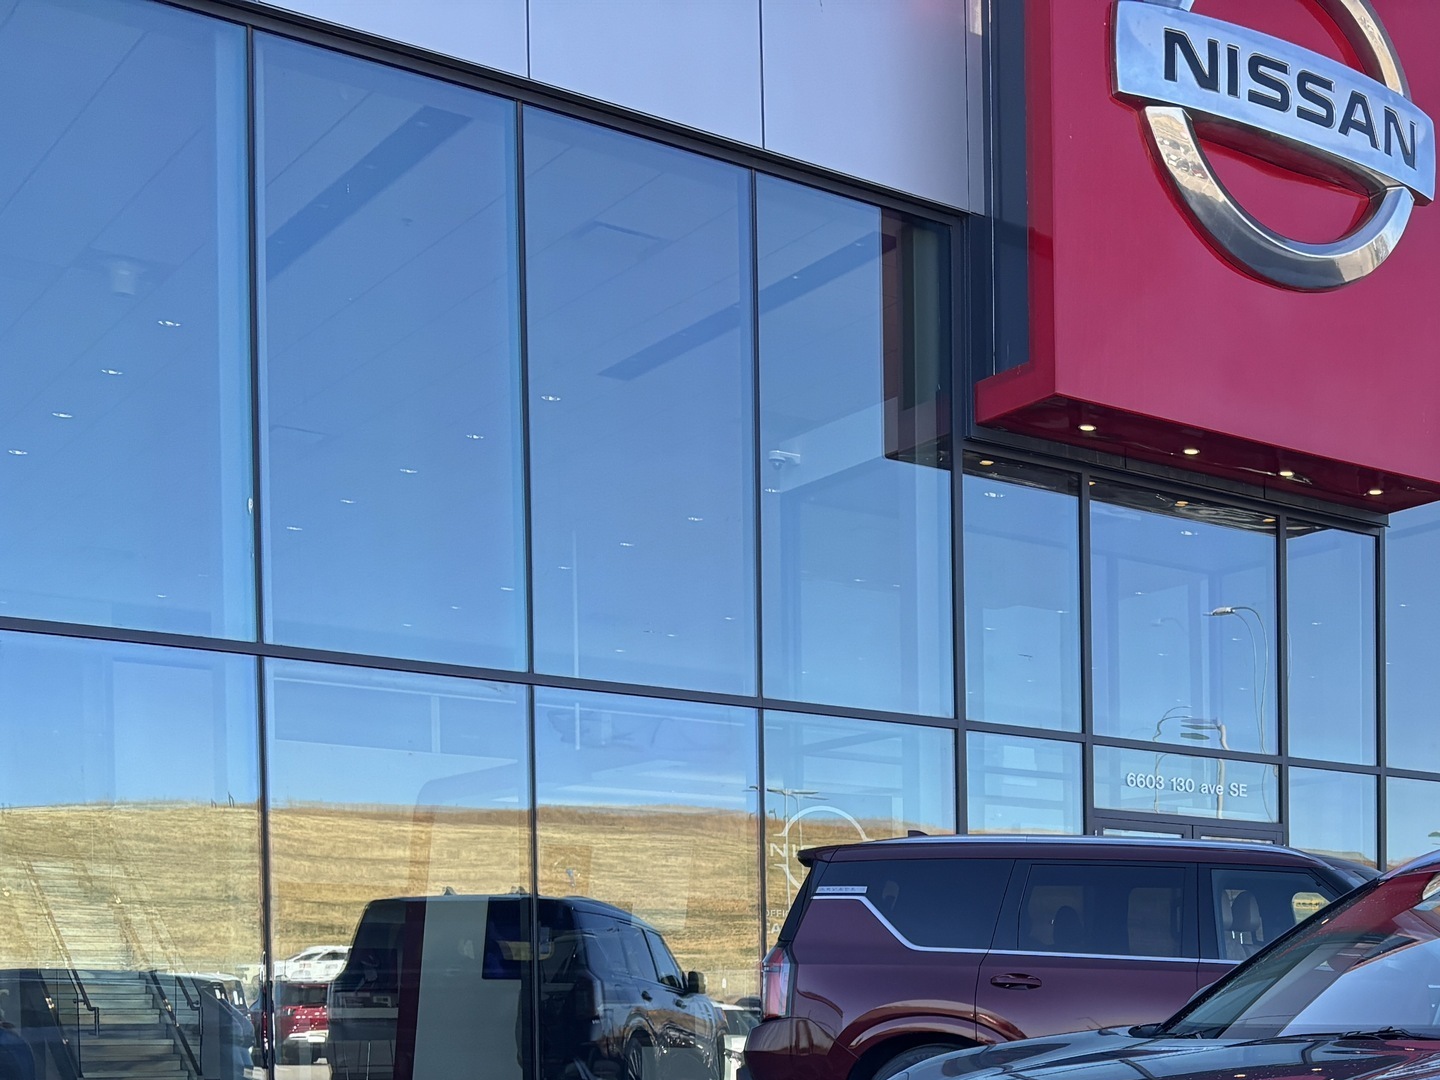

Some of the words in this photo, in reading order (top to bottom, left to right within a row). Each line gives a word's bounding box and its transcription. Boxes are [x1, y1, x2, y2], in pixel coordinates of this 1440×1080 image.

[1163, 26, 1418, 171] NISSAN
[1126, 772, 1165, 790] 6603
[1170, 776, 1195, 793] 130
[1200, 782, 1224, 796] ave
[1229, 782, 1248, 798] SE
